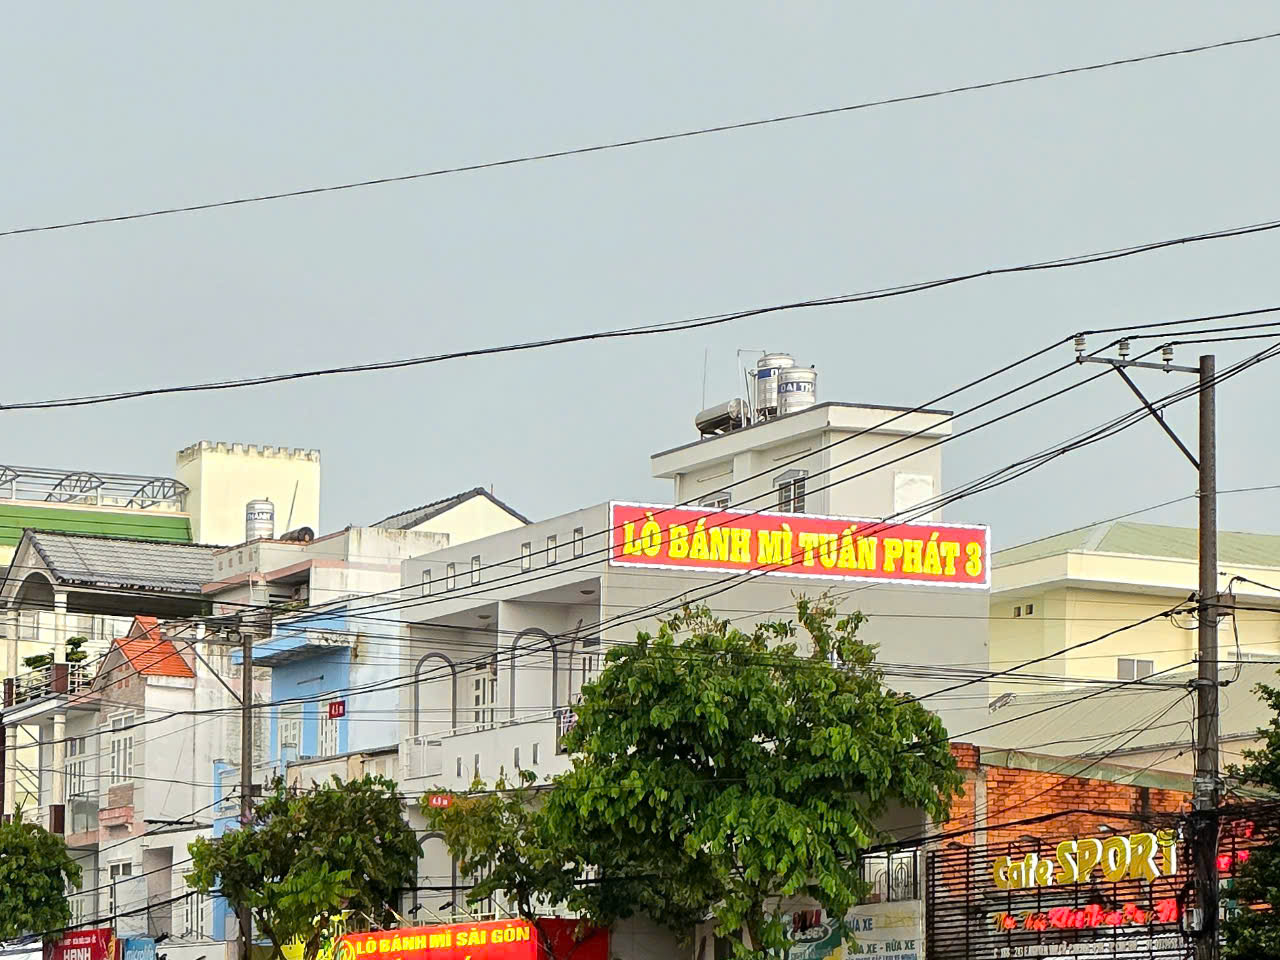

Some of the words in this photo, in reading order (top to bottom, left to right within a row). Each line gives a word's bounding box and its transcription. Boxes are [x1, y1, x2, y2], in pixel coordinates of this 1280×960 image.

[623, 512, 662, 557] LÒ
[668, 518, 751, 562] BÁNH
[757, 523, 793, 566] MÌ
[798, 525, 877, 572] TUẤN
[883, 531, 960, 576] PHÁT
[965, 542, 982, 577] 3
[993, 852, 1054, 889] Cafe
[356, 937, 377, 955] LÒ
[379, 935, 427, 953] BÁNH
[429, 929, 452, 949] MÌ
[456, 927, 487, 946] SÀI
[491, 924, 530, 944] GÒN
[866, 943, 877, 954] XE
[904, 939, 915, 950] XE
